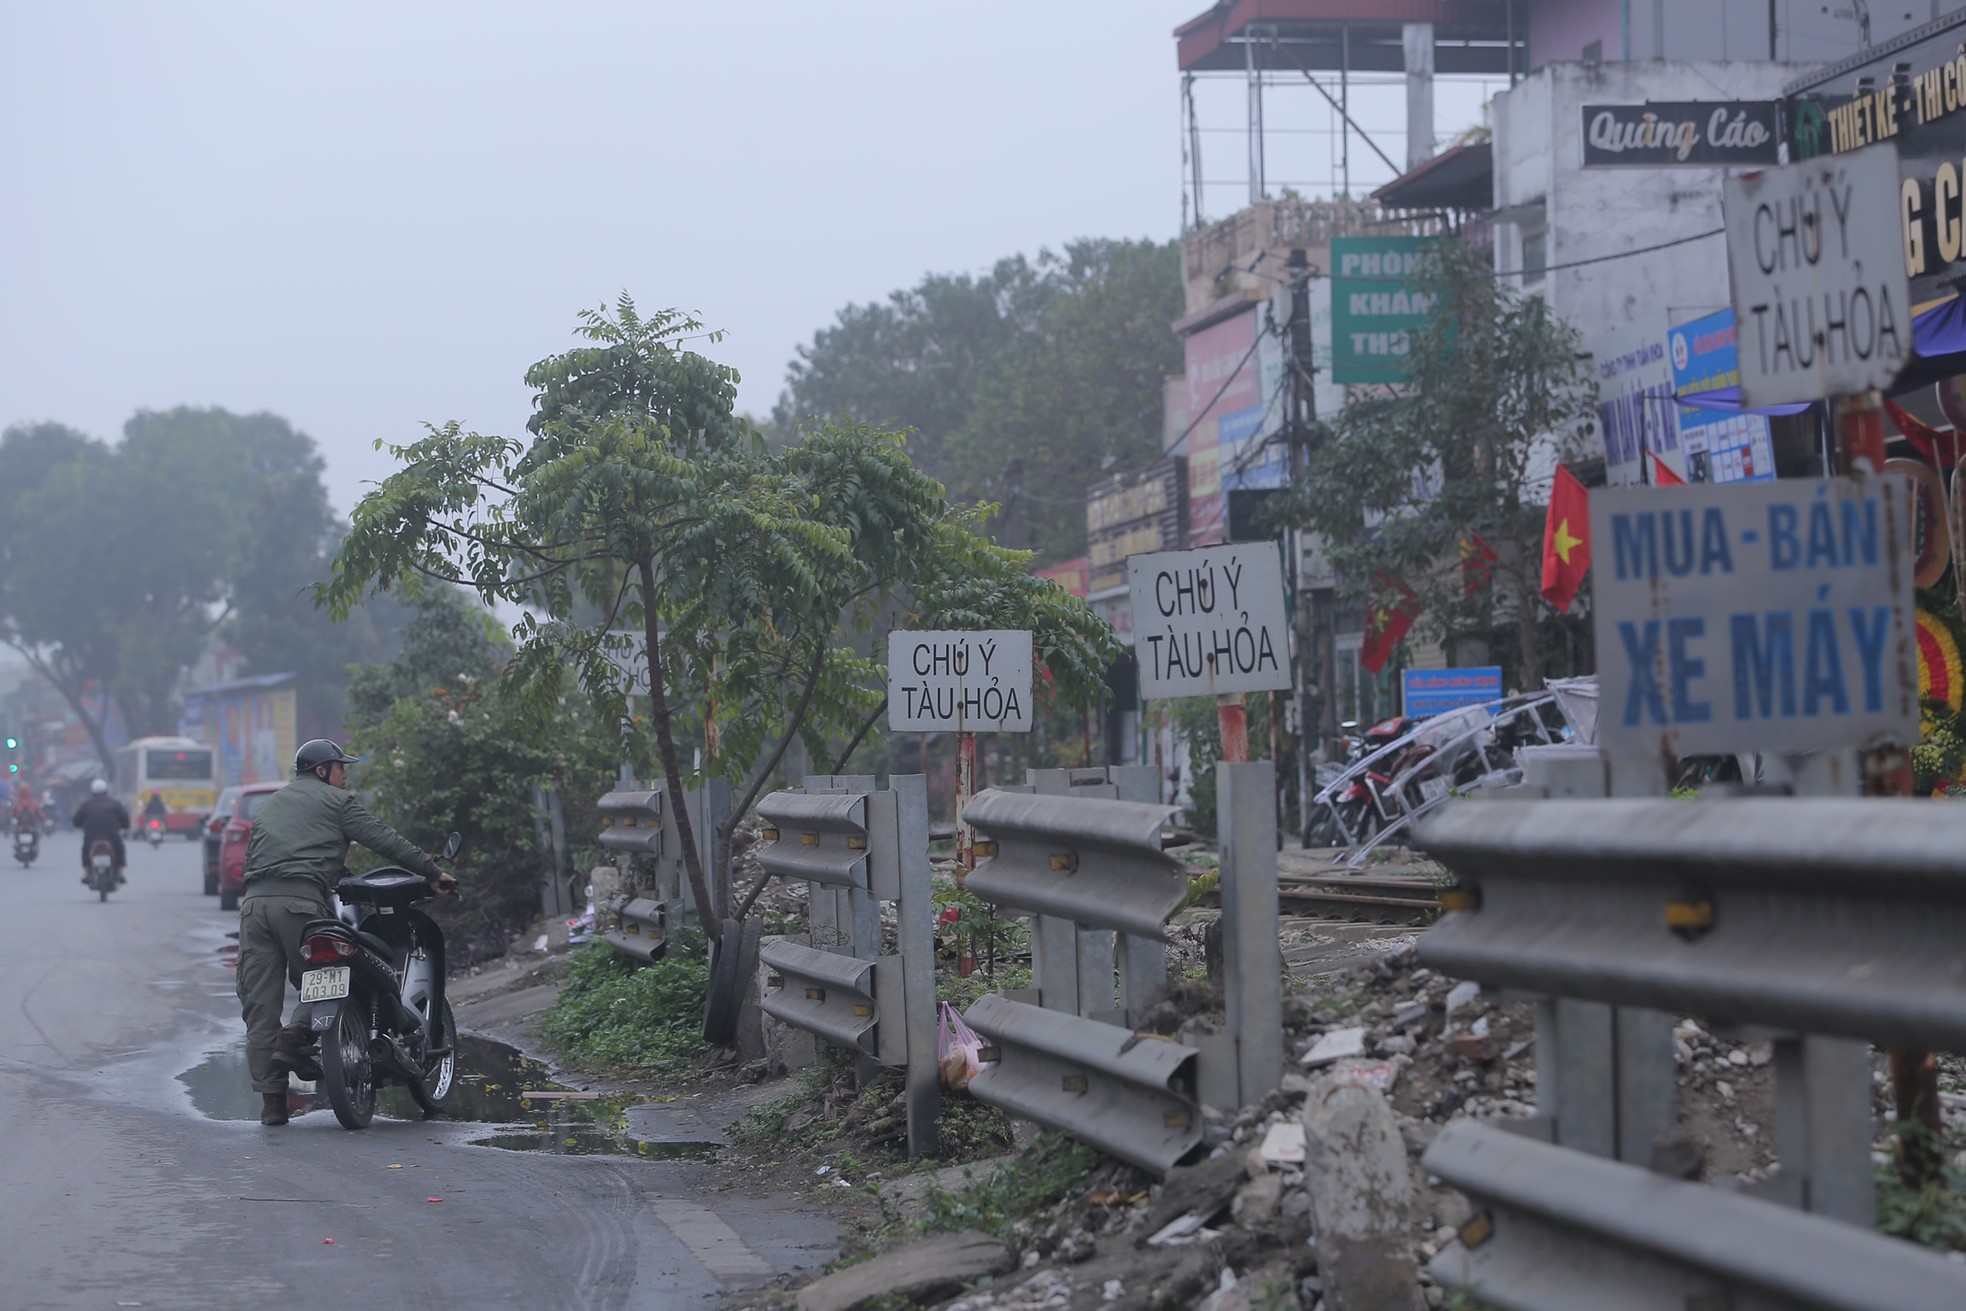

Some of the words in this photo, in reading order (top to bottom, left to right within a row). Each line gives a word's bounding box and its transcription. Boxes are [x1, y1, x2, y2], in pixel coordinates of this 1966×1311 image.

[1589, 111, 1700, 161] Quảng
[1707, 107, 1770, 147] Cáo
[1828, 77, 1873, 154] THIẾT
[1875, 63, 1899, 140] KẾ
[1914, 66, 1943, 125] THI
[1754, 177, 1822, 275] CHÚ
[1829, 168, 1852, 260] Ý
[1752, 284, 1815, 376] TÀU
[1824, 260, 1902, 365] HỎA
[1156, 559, 1215, 617] CHÚ
[1223, 556, 1242, 610] Ý
[913, 638, 969, 676] CHÚ
[978, 638, 997, 676] Ý
[1147, 624, 1203, 680] TÀU
[1213, 611, 1278, 675] HỎA
[1616, 617, 1712, 728] XE
[1729, 584, 1891, 720] MÁY
[901, 681, 954, 719] TÀU
[964, 676, 1022, 720] HỎA
[309, 971, 343, 986] 29-M1
